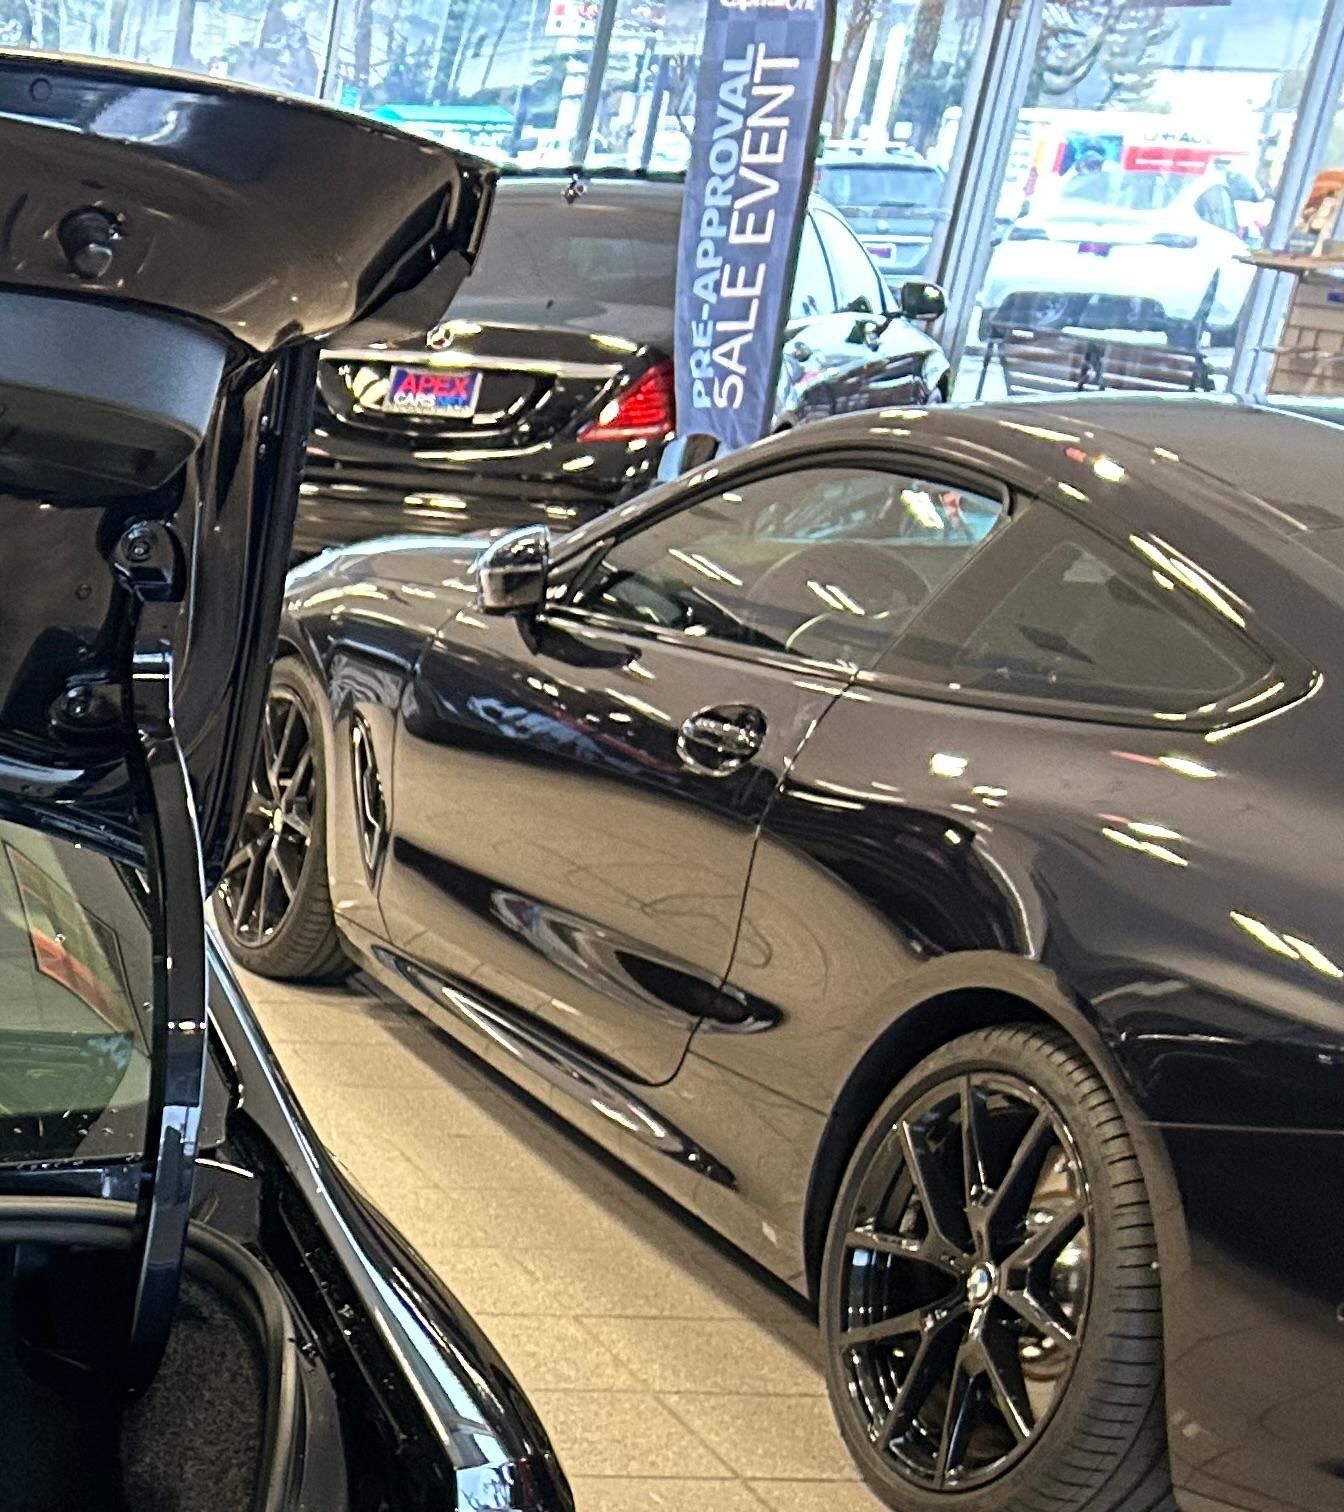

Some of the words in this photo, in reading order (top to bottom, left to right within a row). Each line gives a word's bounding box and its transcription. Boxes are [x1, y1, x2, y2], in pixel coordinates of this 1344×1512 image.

[689, 43, 755, 409] PRE-APPROVAL
[728, 42, 800, 244] EVENT
[397, 372, 470, 398] APEX
[712, 262, 766, 409] SALE
